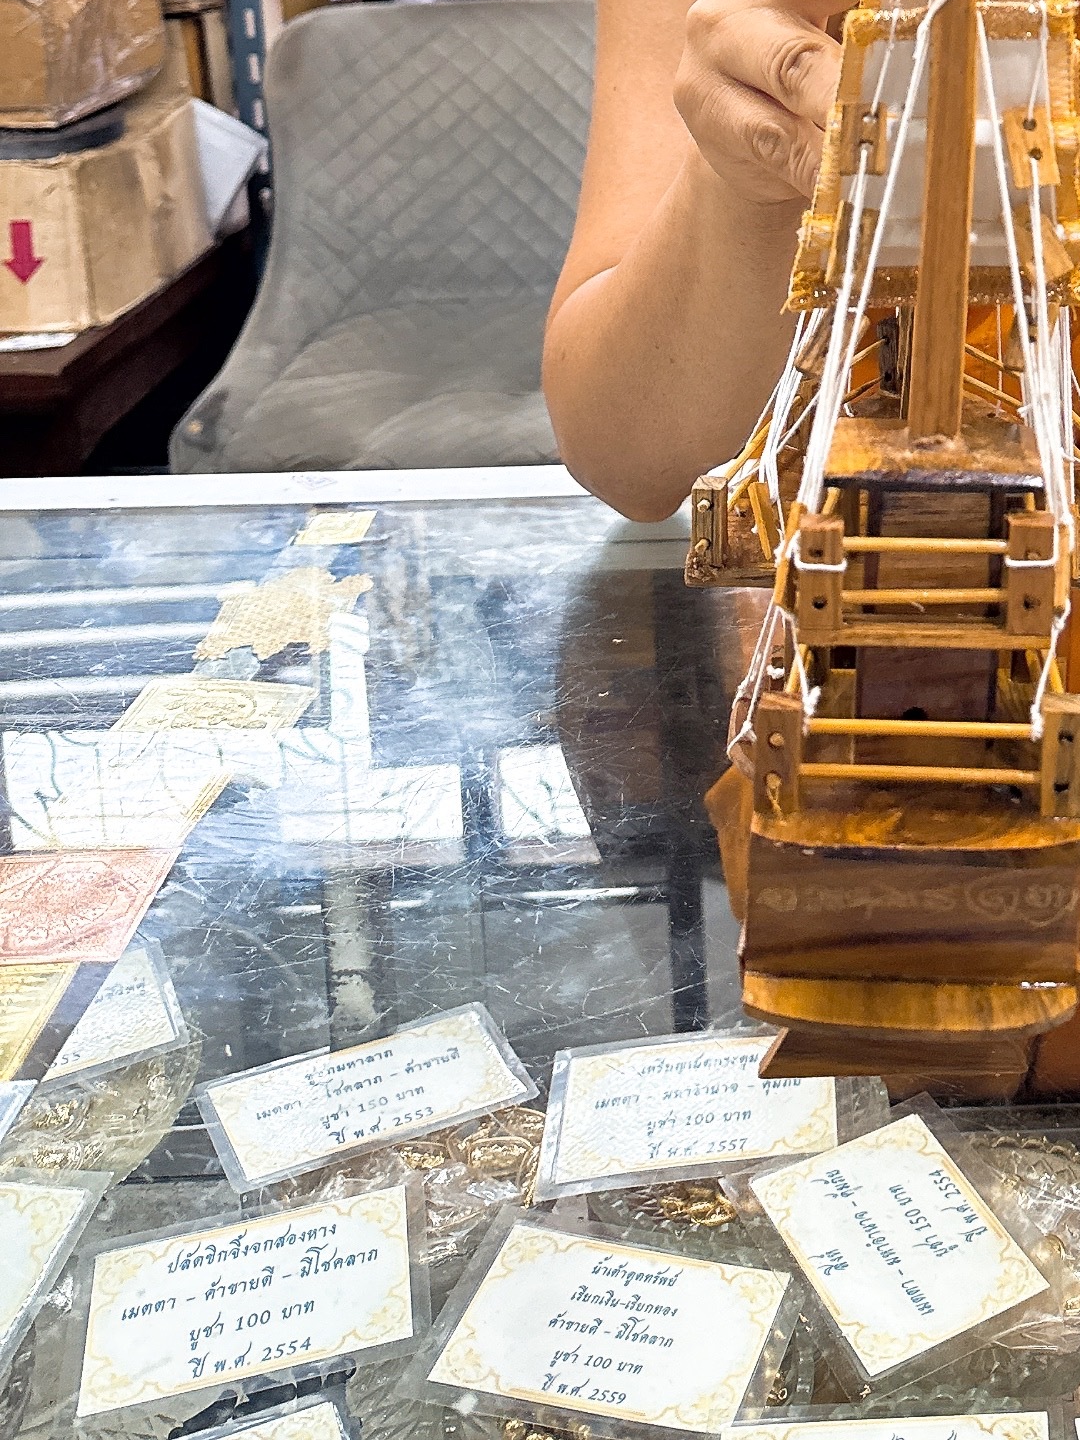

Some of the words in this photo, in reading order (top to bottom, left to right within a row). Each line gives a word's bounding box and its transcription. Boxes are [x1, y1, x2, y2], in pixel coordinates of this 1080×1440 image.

[405, 1046, 460, 1074] ค้าขายดี
[358, 1096, 388, 1113] 150
[396, 1086, 425, 1100] บาท
[328, 1126, 346, 1144] ปี
[392, 1106, 434, 1127] 2553
[724, 1110, 751, 1122] บาท
[706, 1138, 748, 1154] 2557
[889, 1184, 913, 1207] บาท
[928, 1169, 961, 1198] 2554
[905, 1208, 932, 1232] 150
[960, 1226, 988, 1242] ปี
[854, 1211, 901, 1266] มหาอำนาจ
[912, 1234, 958, 1258] บูชา
[121, 1296, 176, 1322] เมตตา
[204, 1265, 274, 1301] ค้าขายดี
[298, 1246, 379, 1279] มีโชคลาภ
[901, 1280, 935, 1316] เมตตา
[189, 1312, 224, 1350] บูชา
[235, 1310, 272, 1332] 100
[282, 1298, 316, 1320] บาท
[548, 1310, 603, 1334] ค้าขายดี
[614, 1316, 674, 1348] มีโชคลาภ
[188, 1352, 209, 1379] ปี
[214, 1342, 250, 1373] พ.ศ.
[262, 1336, 312, 1362] 2554
[550, 1344, 579, 1368] บูชา
[582, 1354, 613, 1371] 100
[618, 1360, 644, 1375] บาท
[541, 1373, 555, 1392] ปี
[556, 1378, 590, 1399] พ.ศ.
[587, 1388, 627, 1406] 2559
